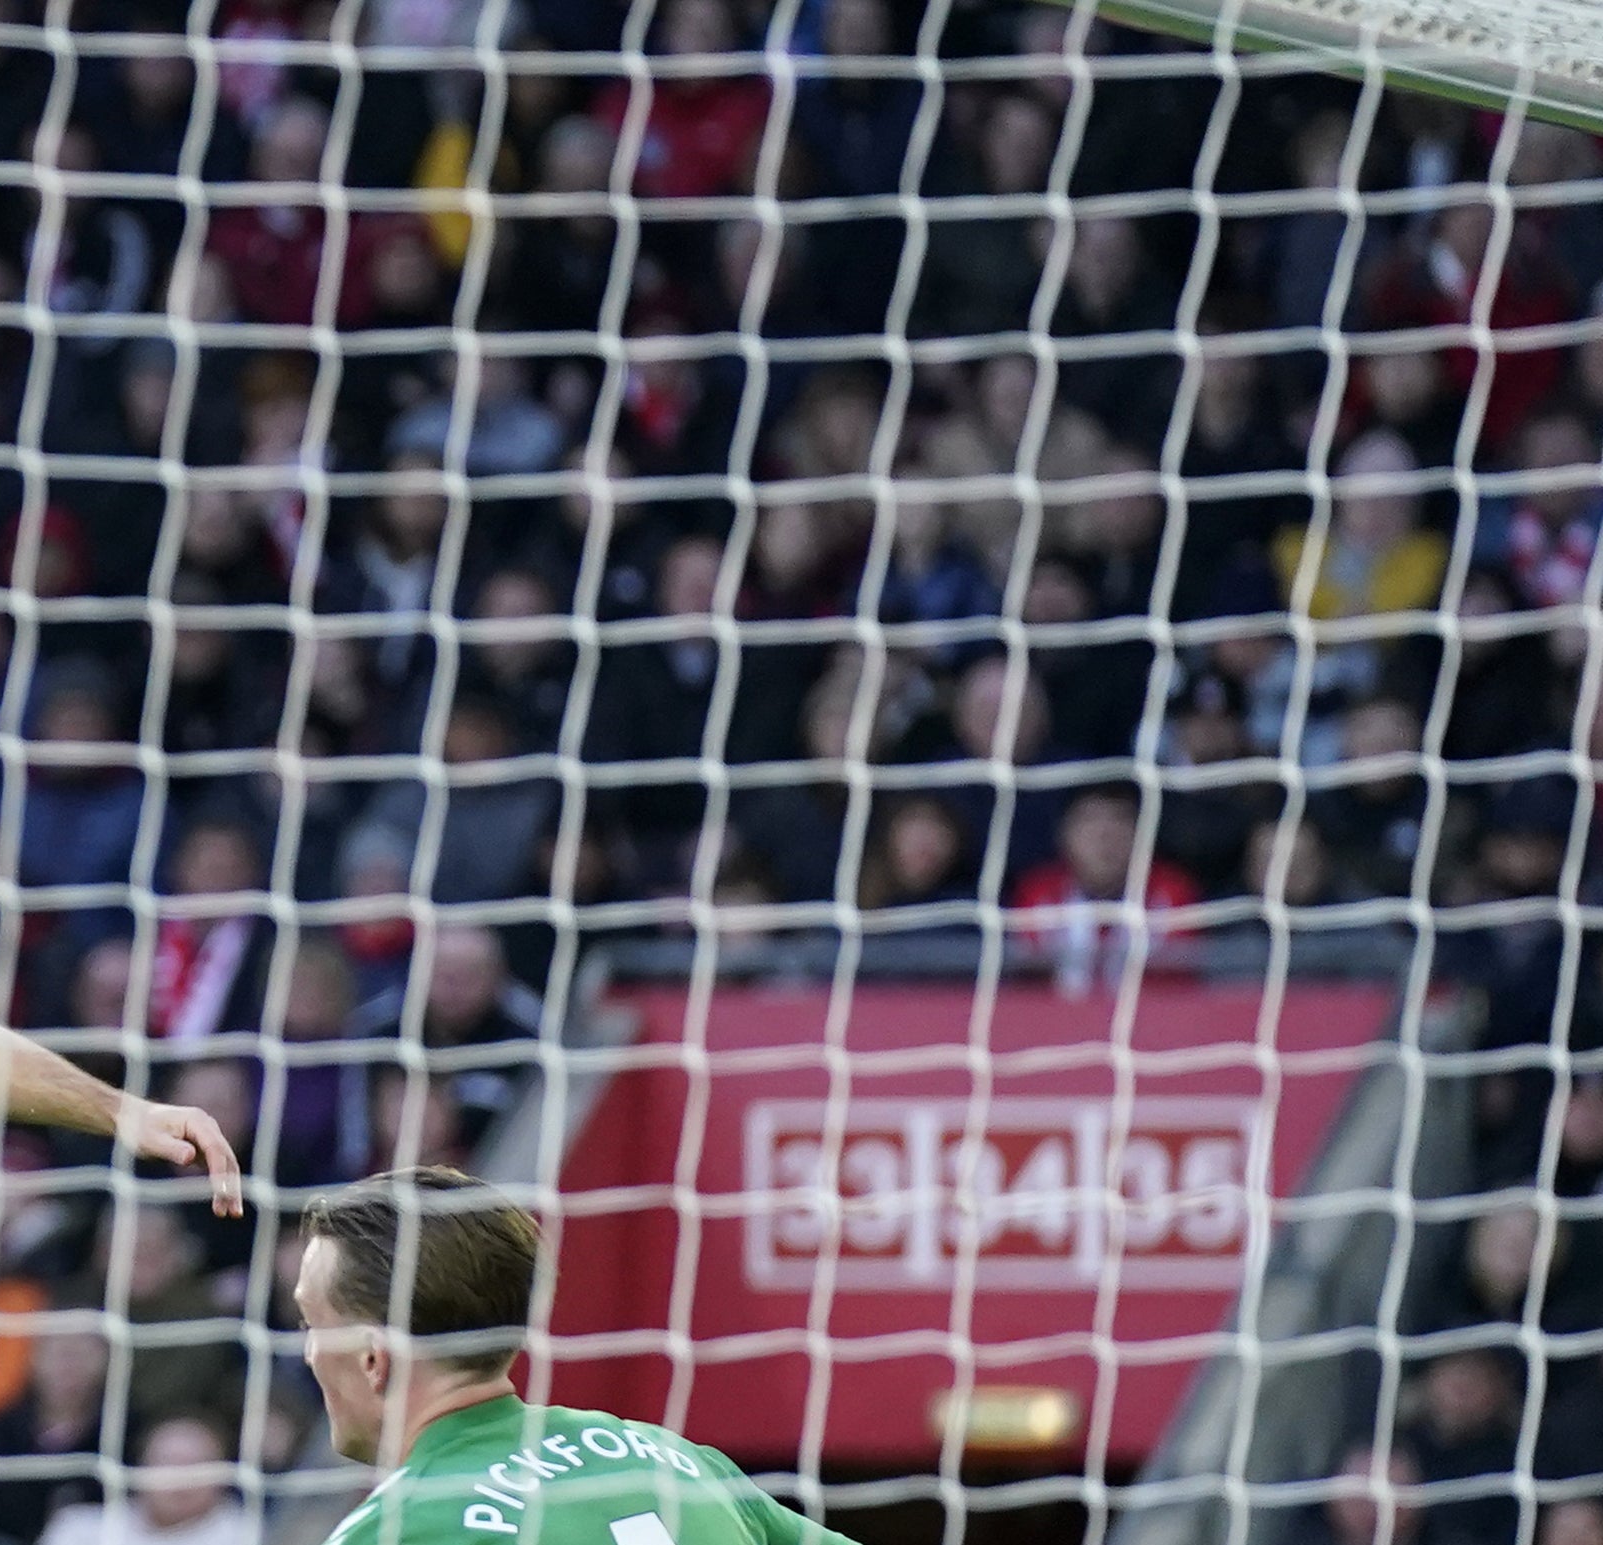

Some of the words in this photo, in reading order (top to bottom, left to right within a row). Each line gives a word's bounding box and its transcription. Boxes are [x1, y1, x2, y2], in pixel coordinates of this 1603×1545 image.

[775, 1138, 905, 1253] 33
[940, 1138, 1071, 1253] 34
[1108, 1136, 1245, 1252] 35
[462, 1426, 701, 1536] PICKFORD
